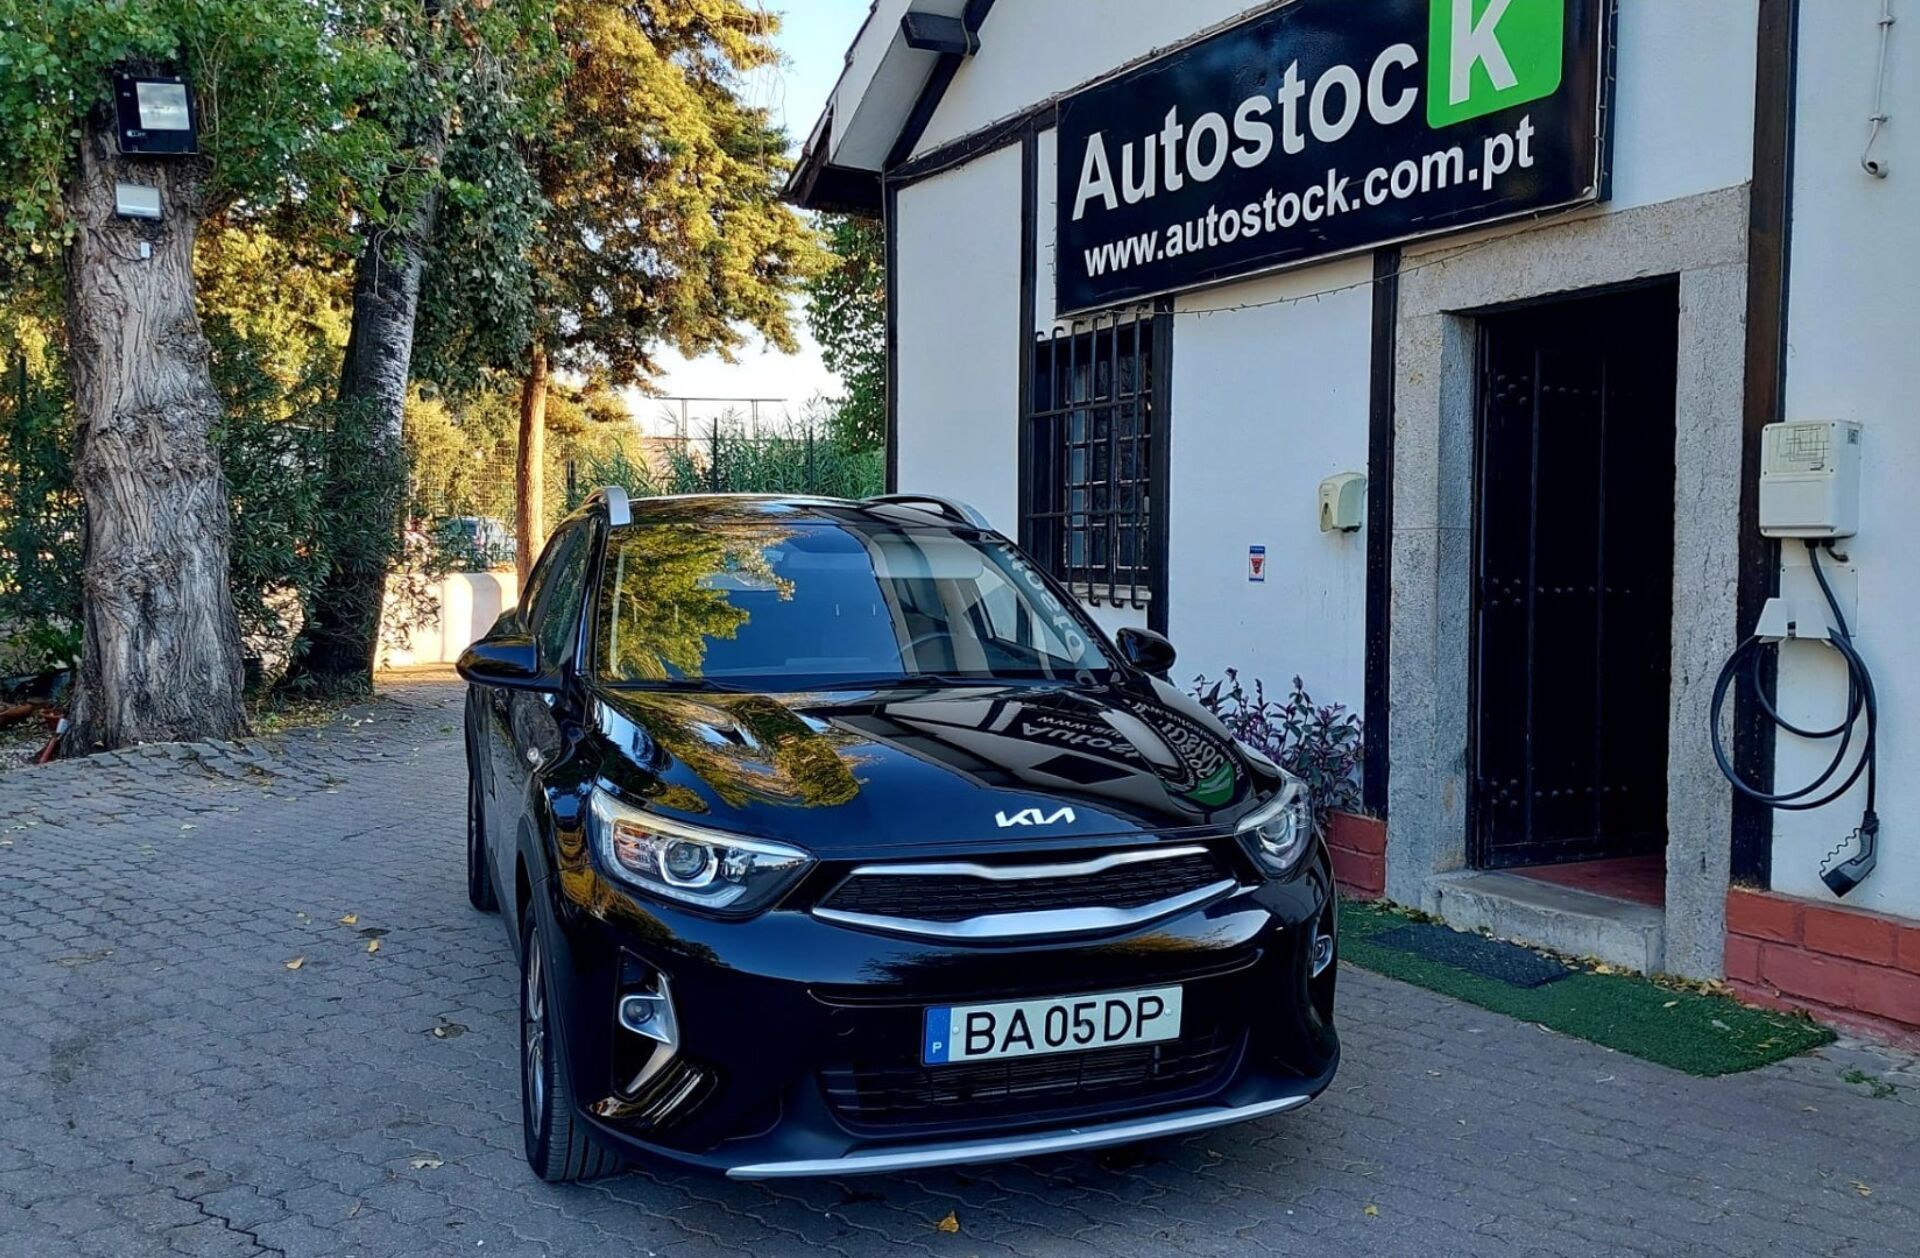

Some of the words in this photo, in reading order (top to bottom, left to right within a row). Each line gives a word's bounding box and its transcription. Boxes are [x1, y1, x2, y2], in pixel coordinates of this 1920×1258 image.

[1084, 114, 1534, 278] www.autostock.com.pt
[995, 806, 1076, 828] KIA
[932, 1042, 942, 1054] P
